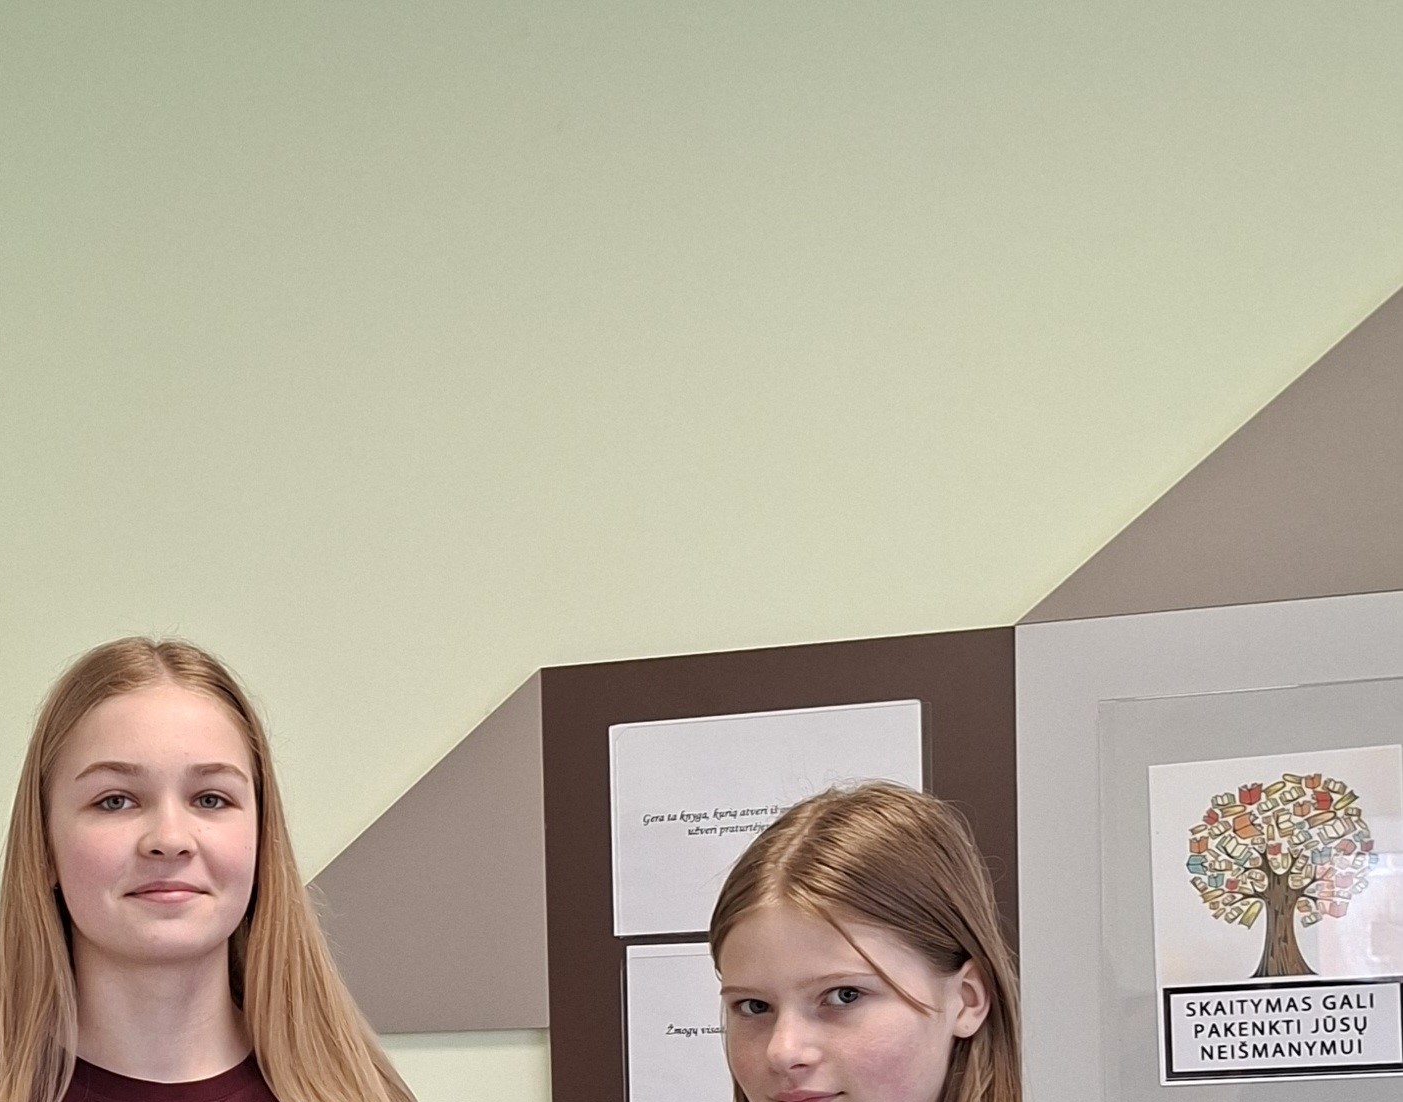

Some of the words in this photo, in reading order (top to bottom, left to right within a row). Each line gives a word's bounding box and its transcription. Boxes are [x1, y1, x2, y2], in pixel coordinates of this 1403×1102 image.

[643, 814, 664, 826] Gera
[667, 813, 677, 822] ta
[679, 810, 710, 824] knyga,
[739, 805, 768, 817] atveri
[688, 824, 717, 836] užveri
[1186, 996, 1312, 1017] SKAITYMAS
[1323, 993, 1374, 1010] GALI
[1194, 1019, 1301, 1039] PAKENKTI
[1311, 1016, 1367, 1035] JŪSŲ
[1201, 1039, 1362, 1061] NEIŠMANYMUI
